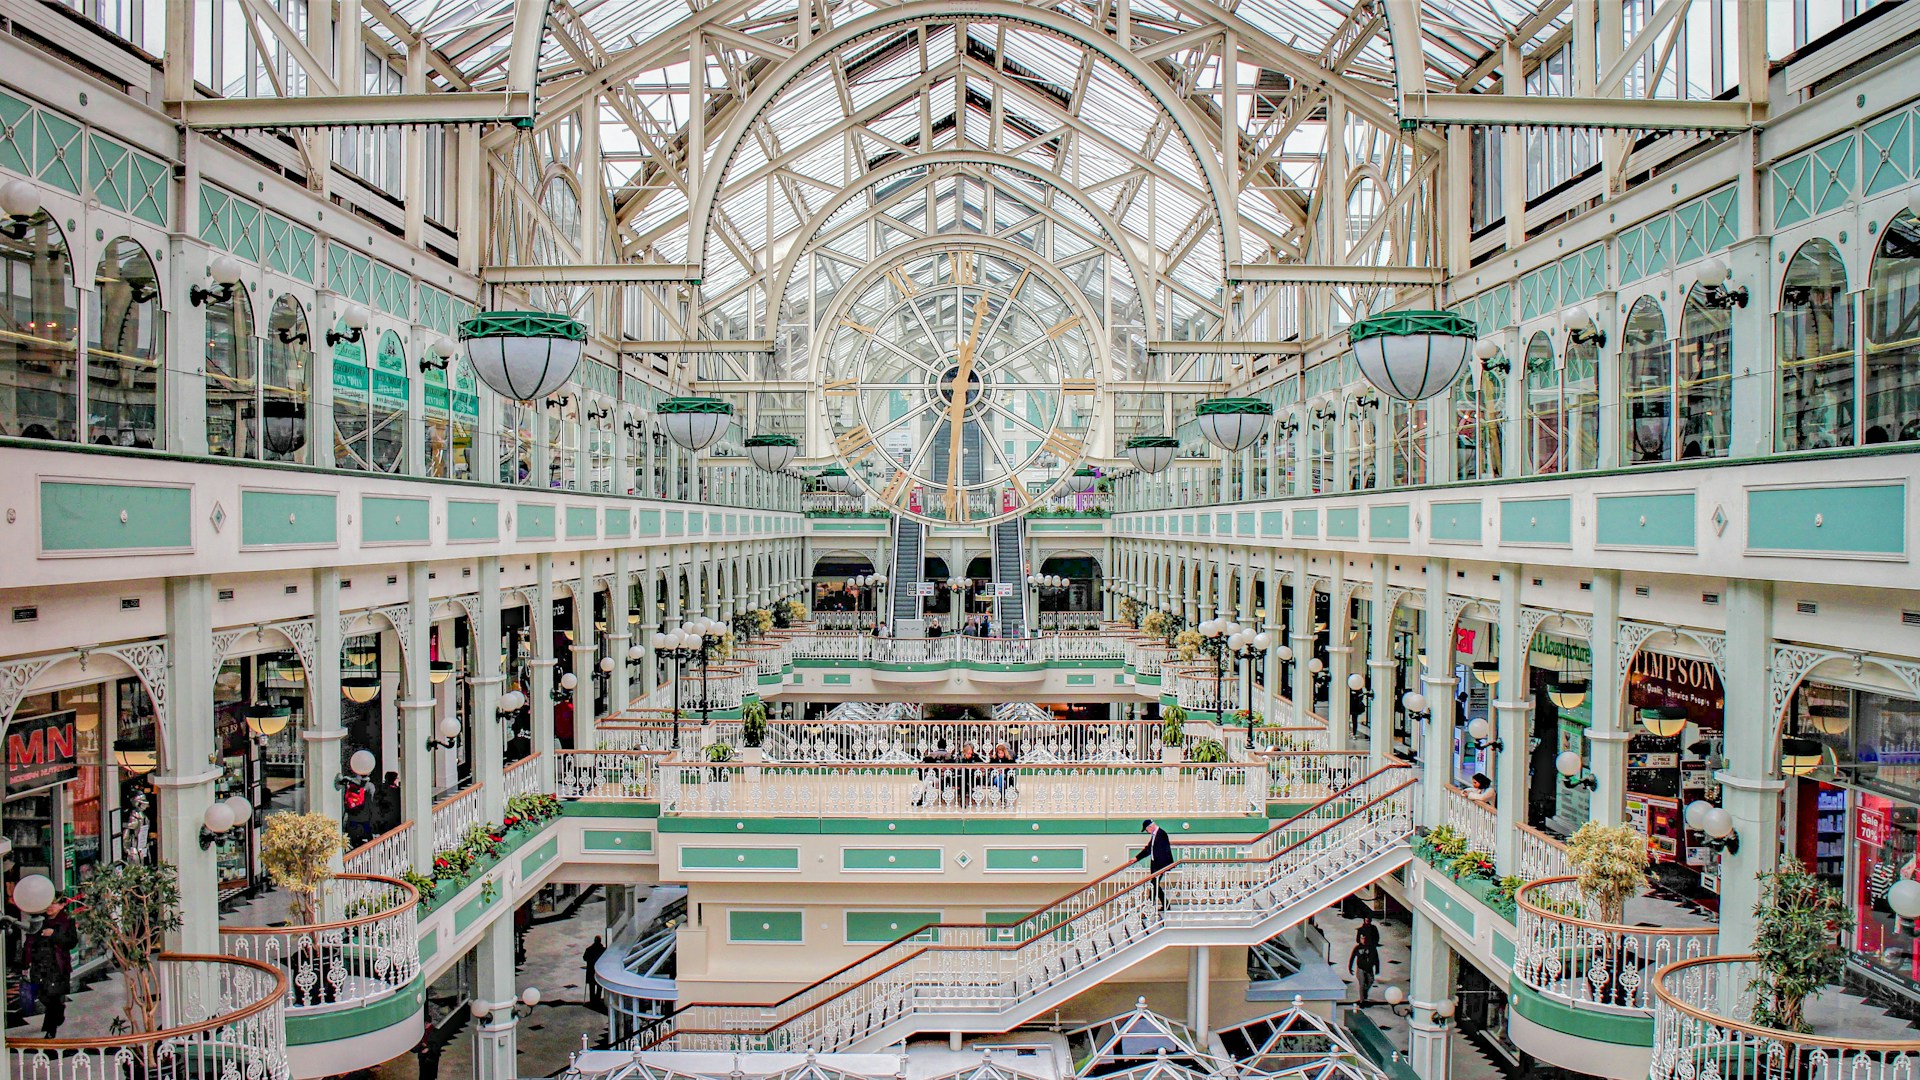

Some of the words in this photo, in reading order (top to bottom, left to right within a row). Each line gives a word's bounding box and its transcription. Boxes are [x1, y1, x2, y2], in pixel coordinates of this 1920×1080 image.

[1543, 636, 1592, 663] Acupuncture
[1634, 650, 1715, 691] TIMPSON
[1667, 688, 1688, 701] Service
[1690, 694, 1710, 707] People
[9, 723, 74, 771] MN
[10, 771, 39, 784] MODERN
[1861, 813, 1878, 826] Sale
[1861, 827, 1878, 840] 70%
